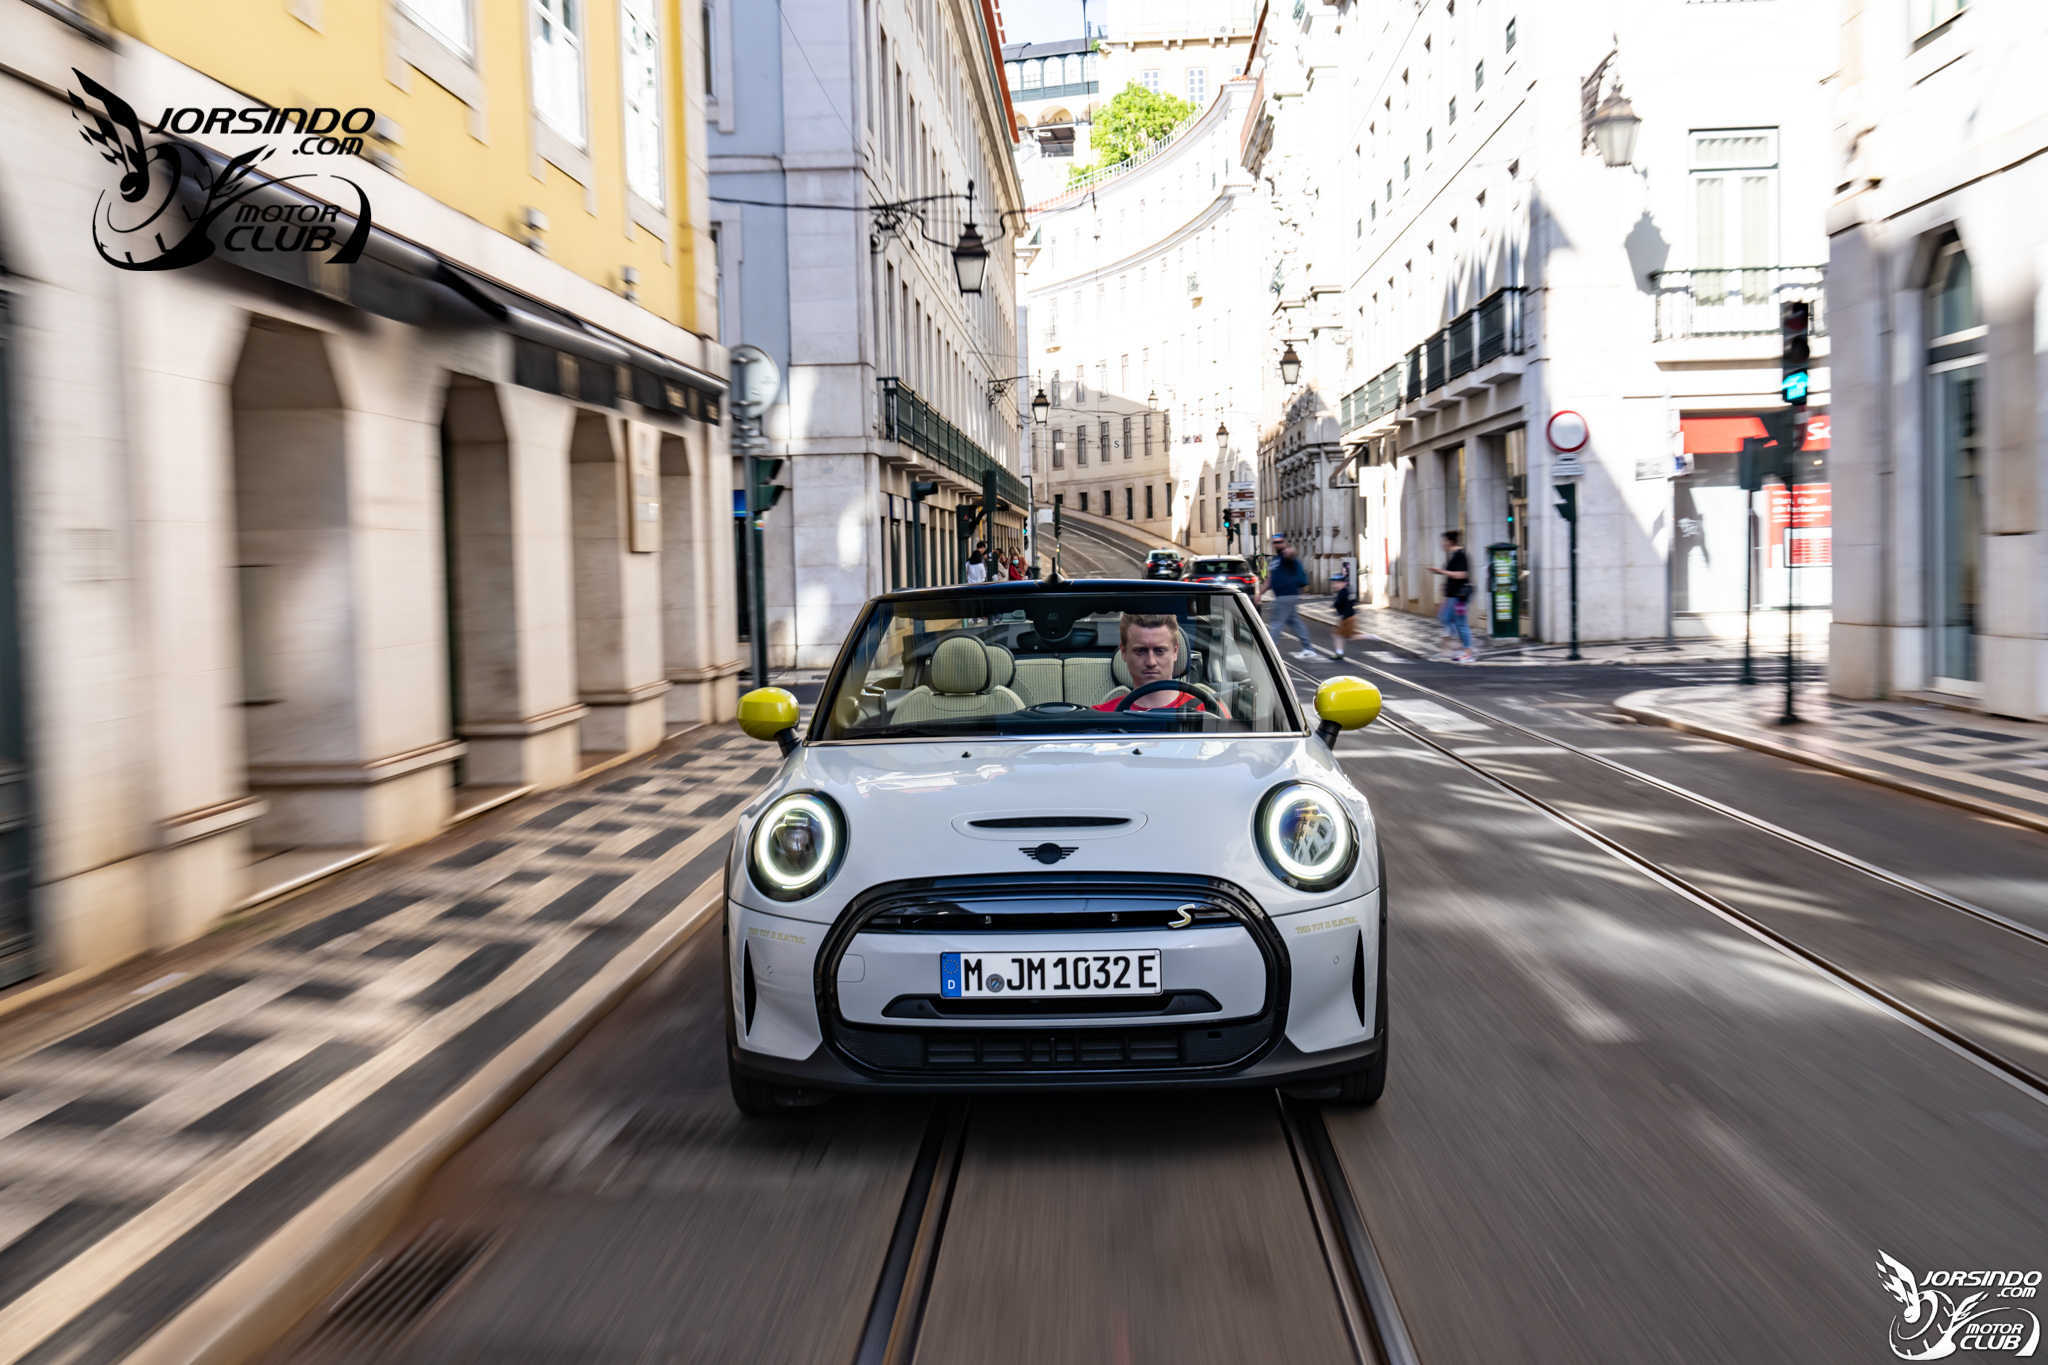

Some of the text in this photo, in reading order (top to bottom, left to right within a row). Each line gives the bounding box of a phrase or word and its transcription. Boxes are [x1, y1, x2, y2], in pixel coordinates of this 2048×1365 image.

[1113, 440, 1120, 449] S
[1167, 903, 1196, 929] S
[748, 927, 759, 936] THIS
[759, 929, 771, 938] TOY
[770, 931, 777, 939] IS
[1296, 925, 1311, 934] THIS
[1311, 922, 1324, 931] TOY
[1325, 920, 1331, 929] IS
[947, 979, 955, 990] D
[964, 958, 982, 991] M
